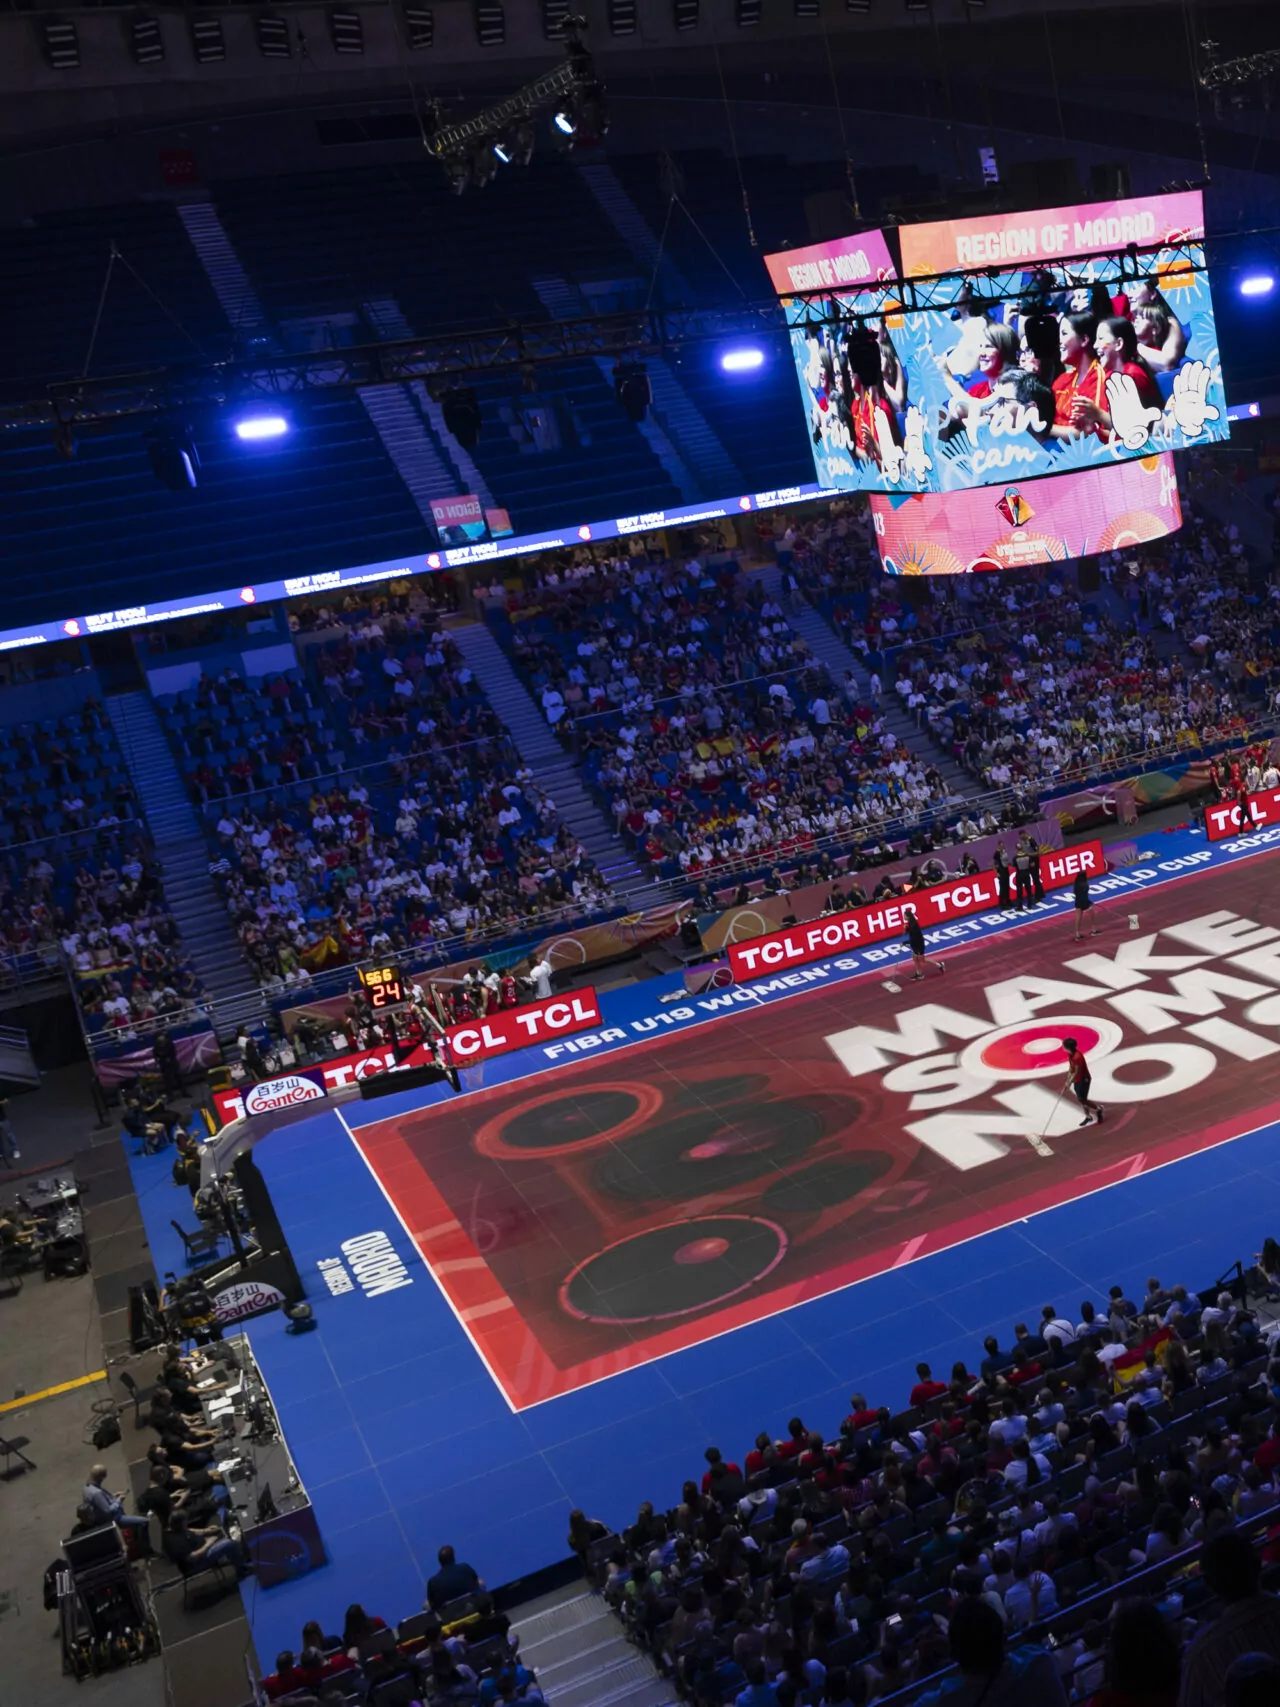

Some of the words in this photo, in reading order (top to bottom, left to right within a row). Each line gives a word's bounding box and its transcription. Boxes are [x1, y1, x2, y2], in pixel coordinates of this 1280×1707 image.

[955, 226, 1036, 264] REGION
[1041, 224, 1070, 254] OF
[1074, 211, 1155, 249] MADRID
[787, 262, 824, 290] REGION
[818, 258, 834, 285] OF
[830, 249, 871, 282] MADRID
[1211, 801, 1267, 831] TCL
[738, 938, 804, 970] TCL
[806, 920, 861, 951] FOR
[866, 902, 919, 934] HER
[930, 883, 990, 913] TCL
[1048, 850, 1096, 880] HER
[543, 1027, 628, 1060] FIBA
[630, 1006, 696, 1032] U19
[697, 958, 860, 1011] WOMEN'S
[862, 900, 1058, 963] BAKETBALL
[1052, 869, 1158, 904] WORLD
[1157, 850, 1213, 872] CUP
[372, 982, 401, 1007] 24
[325, 1052, 411, 1087] TCL
[423, 1025, 507, 1063] TCL
[516, 999, 596, 1036] TCL
[256, 1077, 300, 1097] 百岁山
[316, 1257, 342, 1270] OF
[321, 1265, 355, 1296] REGION
[341, 1230, 414, 1298] MADRID
[216, 1283, 260, 1307] 百岁山
